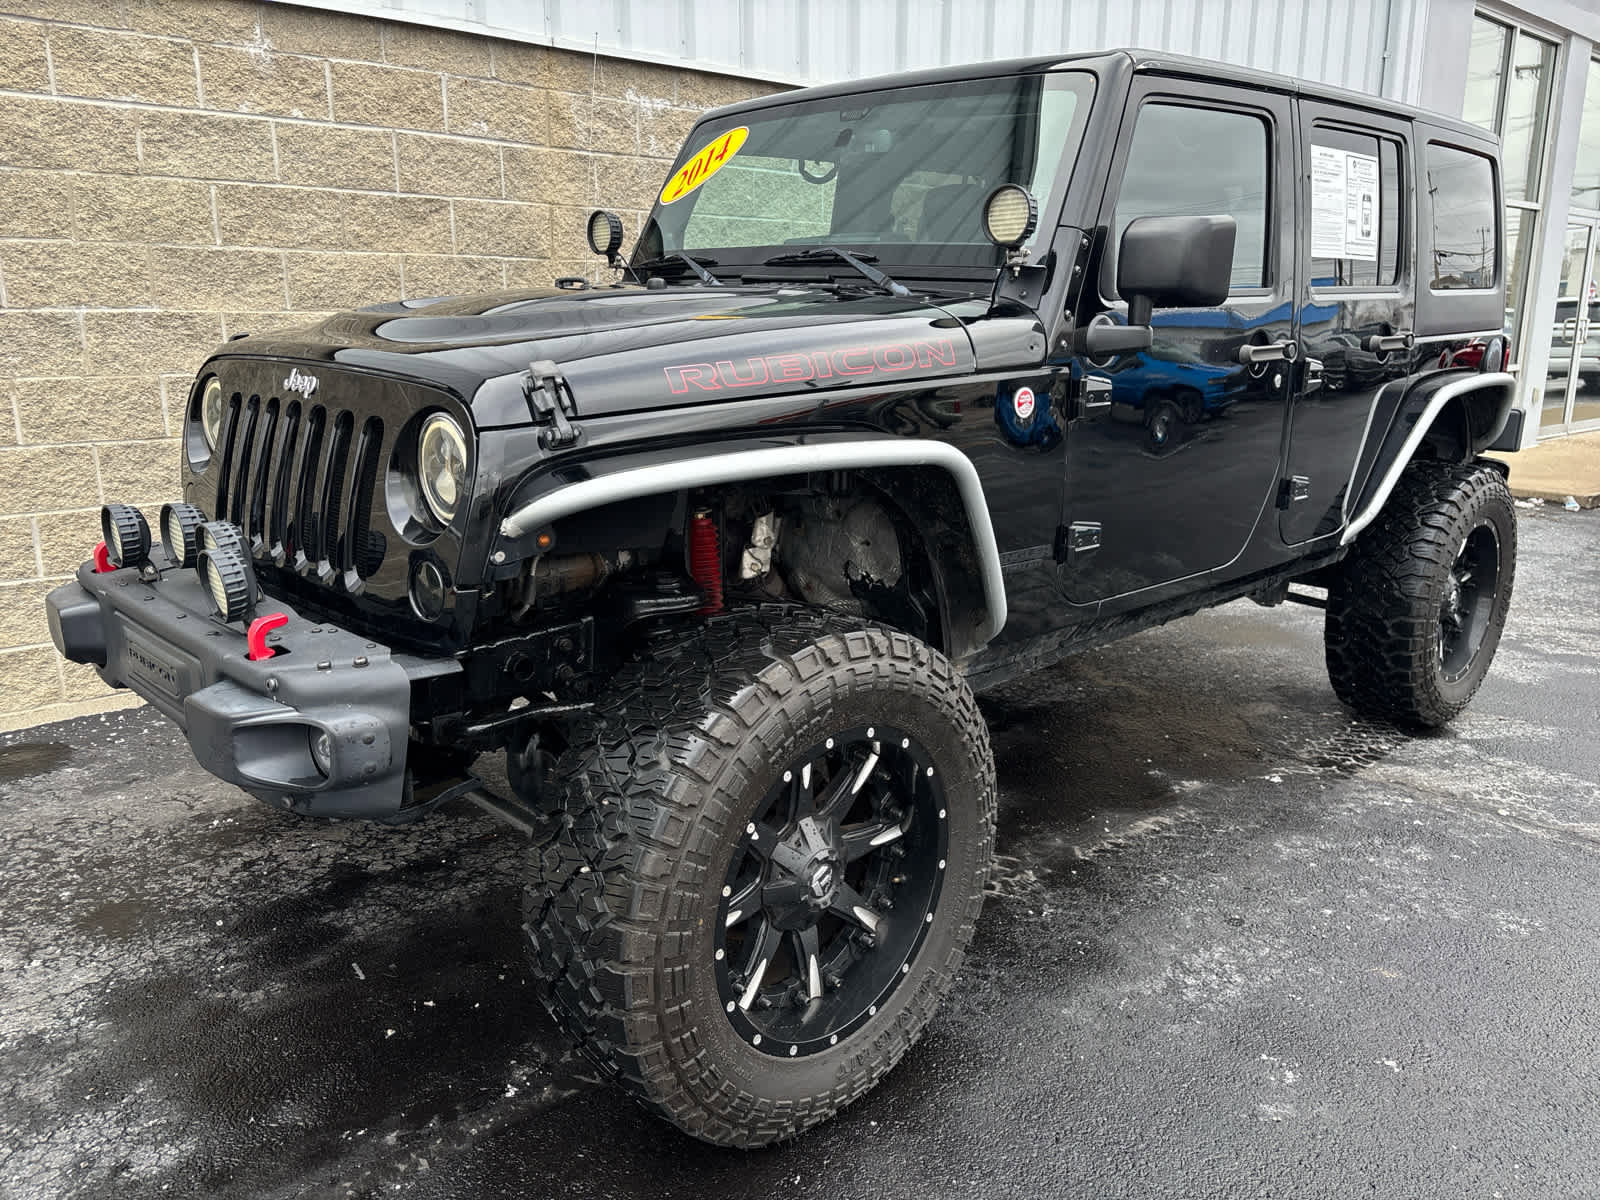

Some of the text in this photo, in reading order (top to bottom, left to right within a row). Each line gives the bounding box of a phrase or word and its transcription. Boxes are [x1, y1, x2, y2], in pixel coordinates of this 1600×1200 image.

[671, 133, 733, 200] 2014
[283, 367, 318, 399] Jeep
[664, 339, 957, 394] RUBICON
